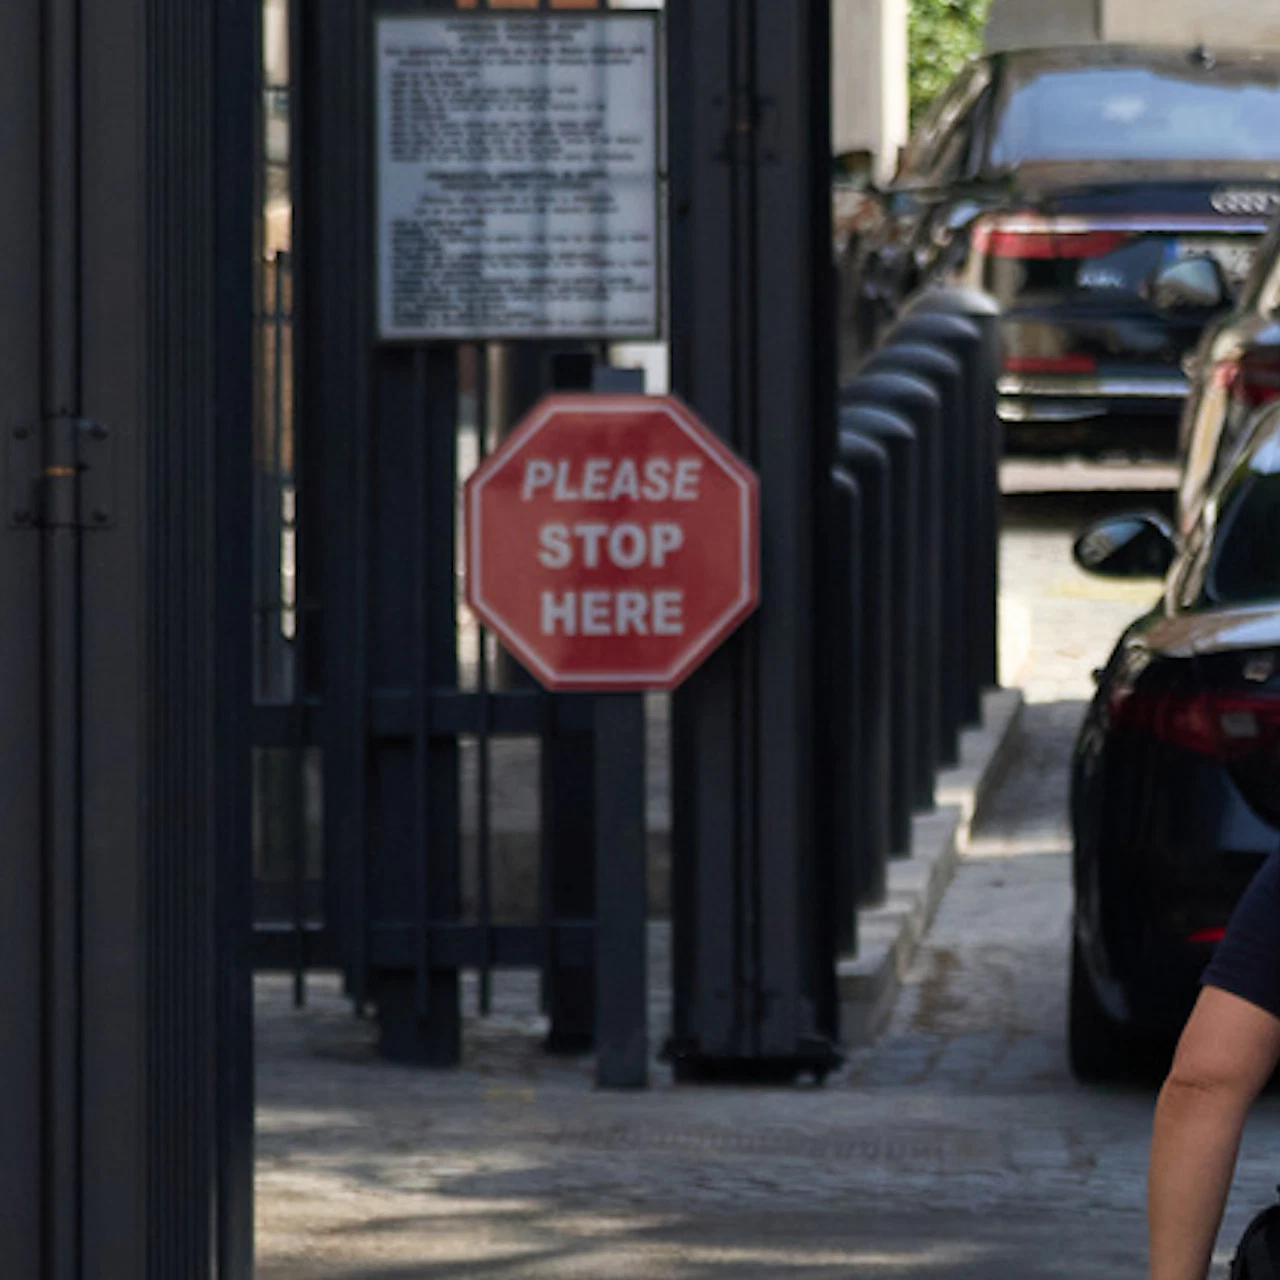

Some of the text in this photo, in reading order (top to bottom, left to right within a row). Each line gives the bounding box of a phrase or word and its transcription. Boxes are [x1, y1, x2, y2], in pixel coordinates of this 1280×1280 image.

[521, 459, 702, 502] PLEASE
[538, 523, 684, 569] STOP
[541, 591, 684, 636] HERE
